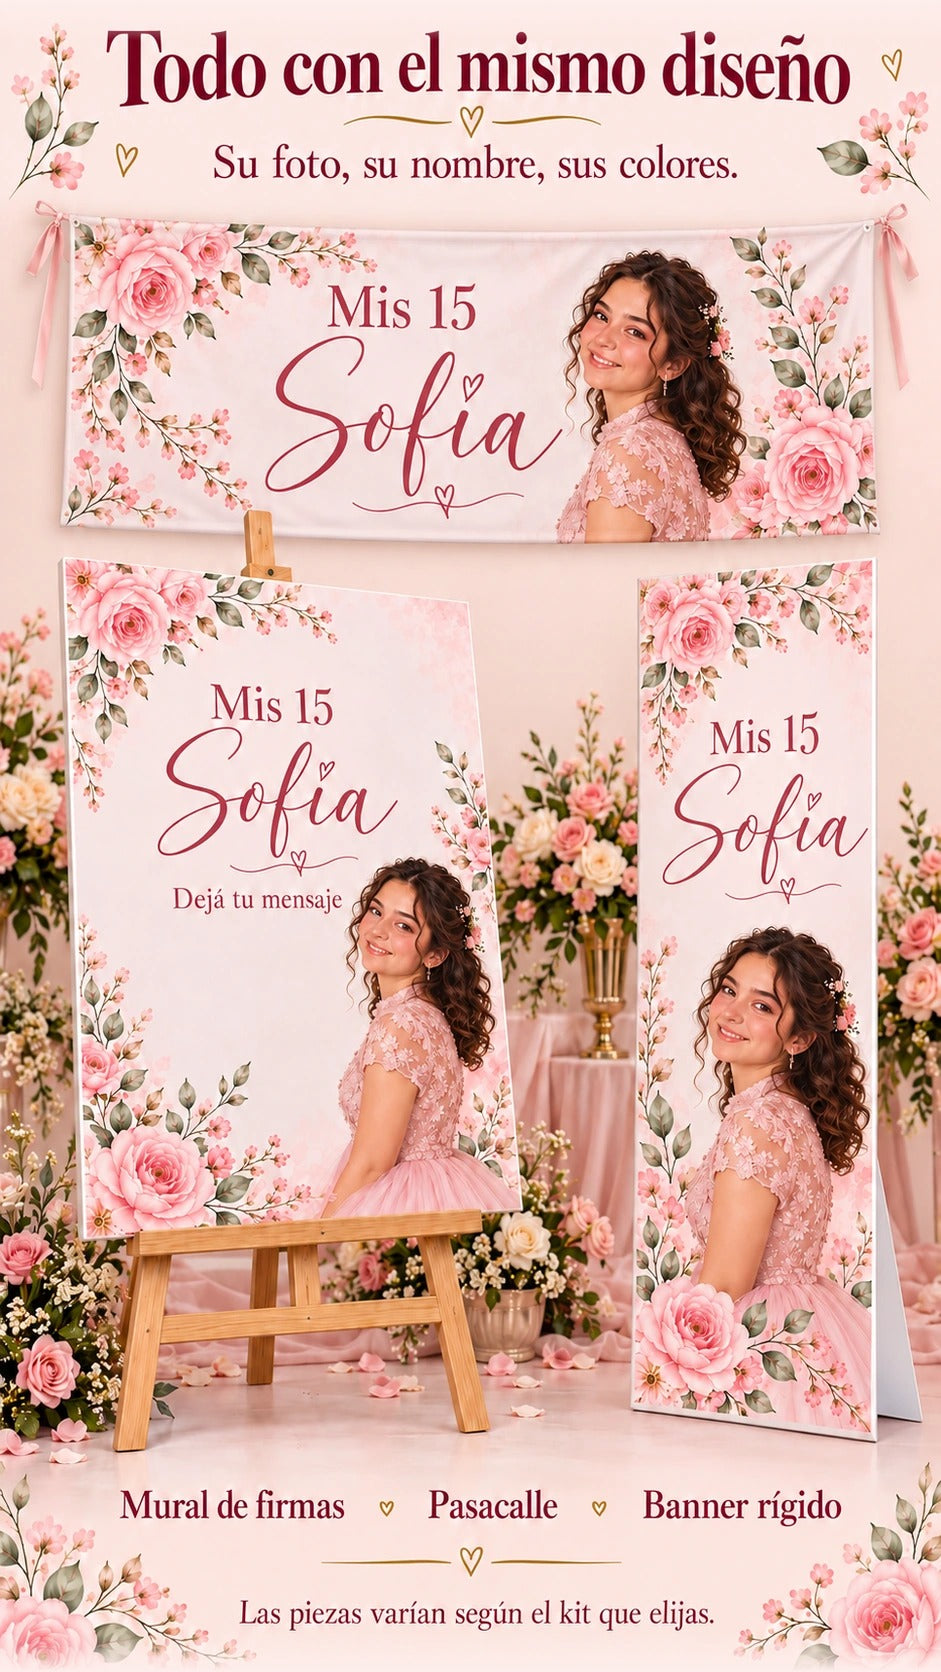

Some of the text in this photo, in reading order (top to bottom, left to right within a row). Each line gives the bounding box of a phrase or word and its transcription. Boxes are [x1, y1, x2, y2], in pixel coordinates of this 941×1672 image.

[327, 283, 476, 331] Mis 15
[210, 683, 333, 726] Mis 15
[710, 711, 819, 756] Mis 15
[173, 887, 342, 915] Dejá tu mensaje
